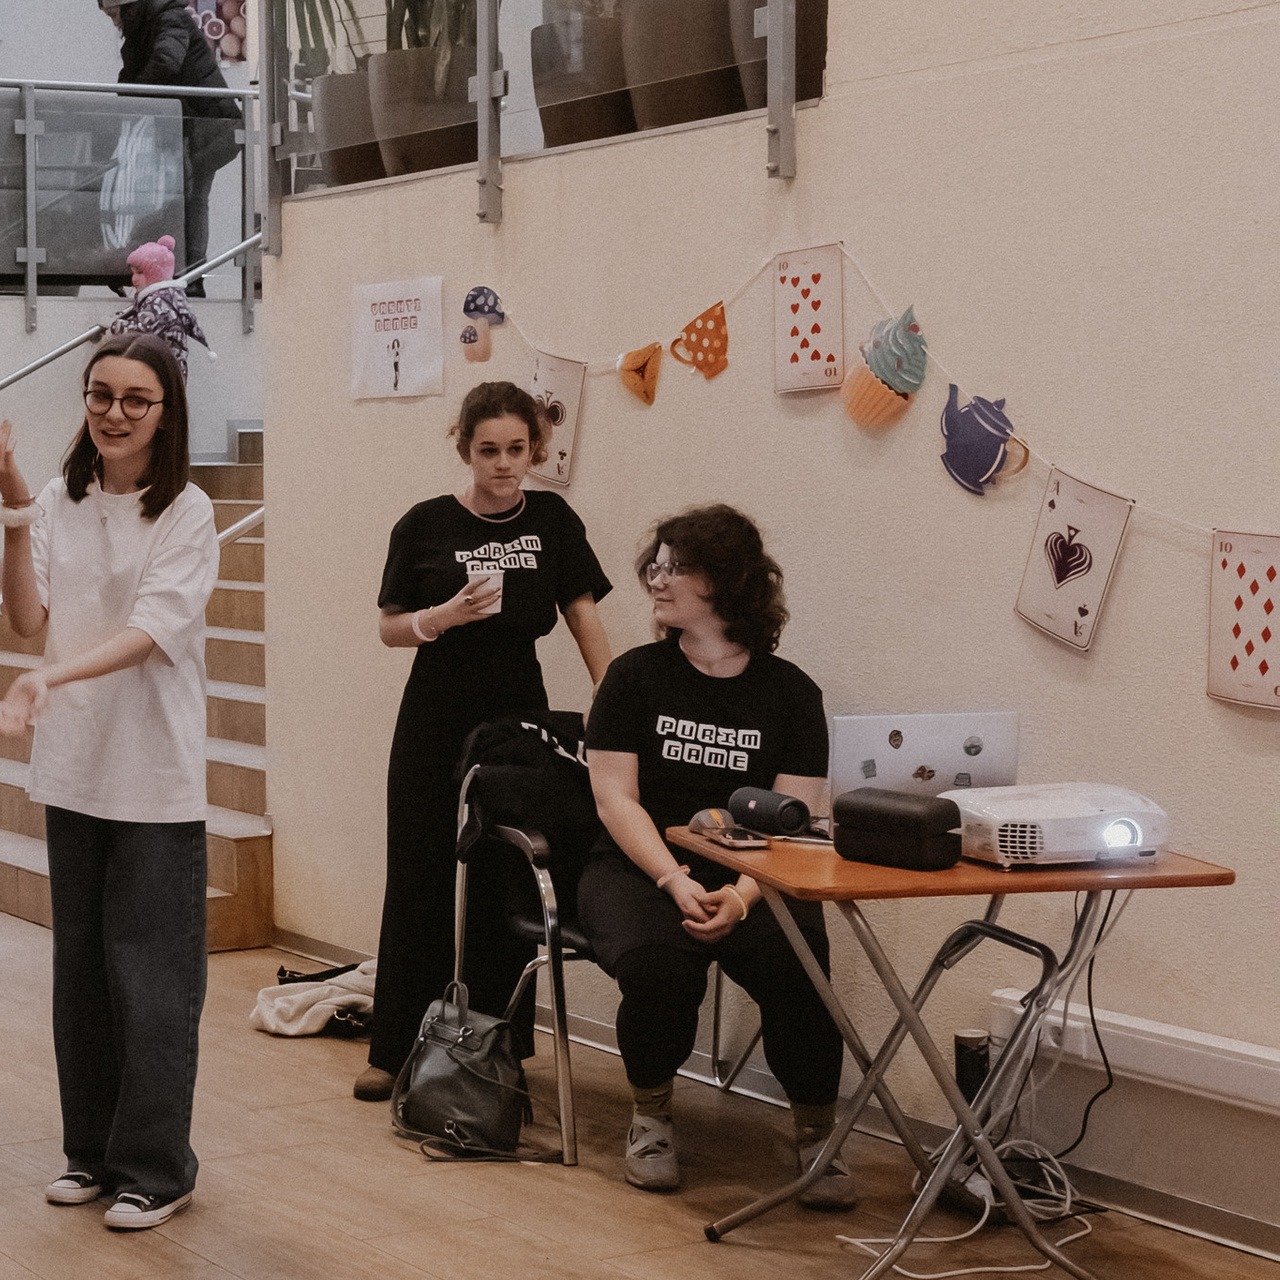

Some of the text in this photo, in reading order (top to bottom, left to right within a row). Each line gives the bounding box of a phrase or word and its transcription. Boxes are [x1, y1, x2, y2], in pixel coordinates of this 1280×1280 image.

[778, 261, 789, 272] 10
[371, 298, 421, 316] VASHTI
[375, 316, 418, 332] DANCE
[455, 535, 542, 563] PURIM
[1219, 541, 1233, 554] 10
[656, 715, 762, 750] PURIM
[662, 739, 749, 772] GAME
